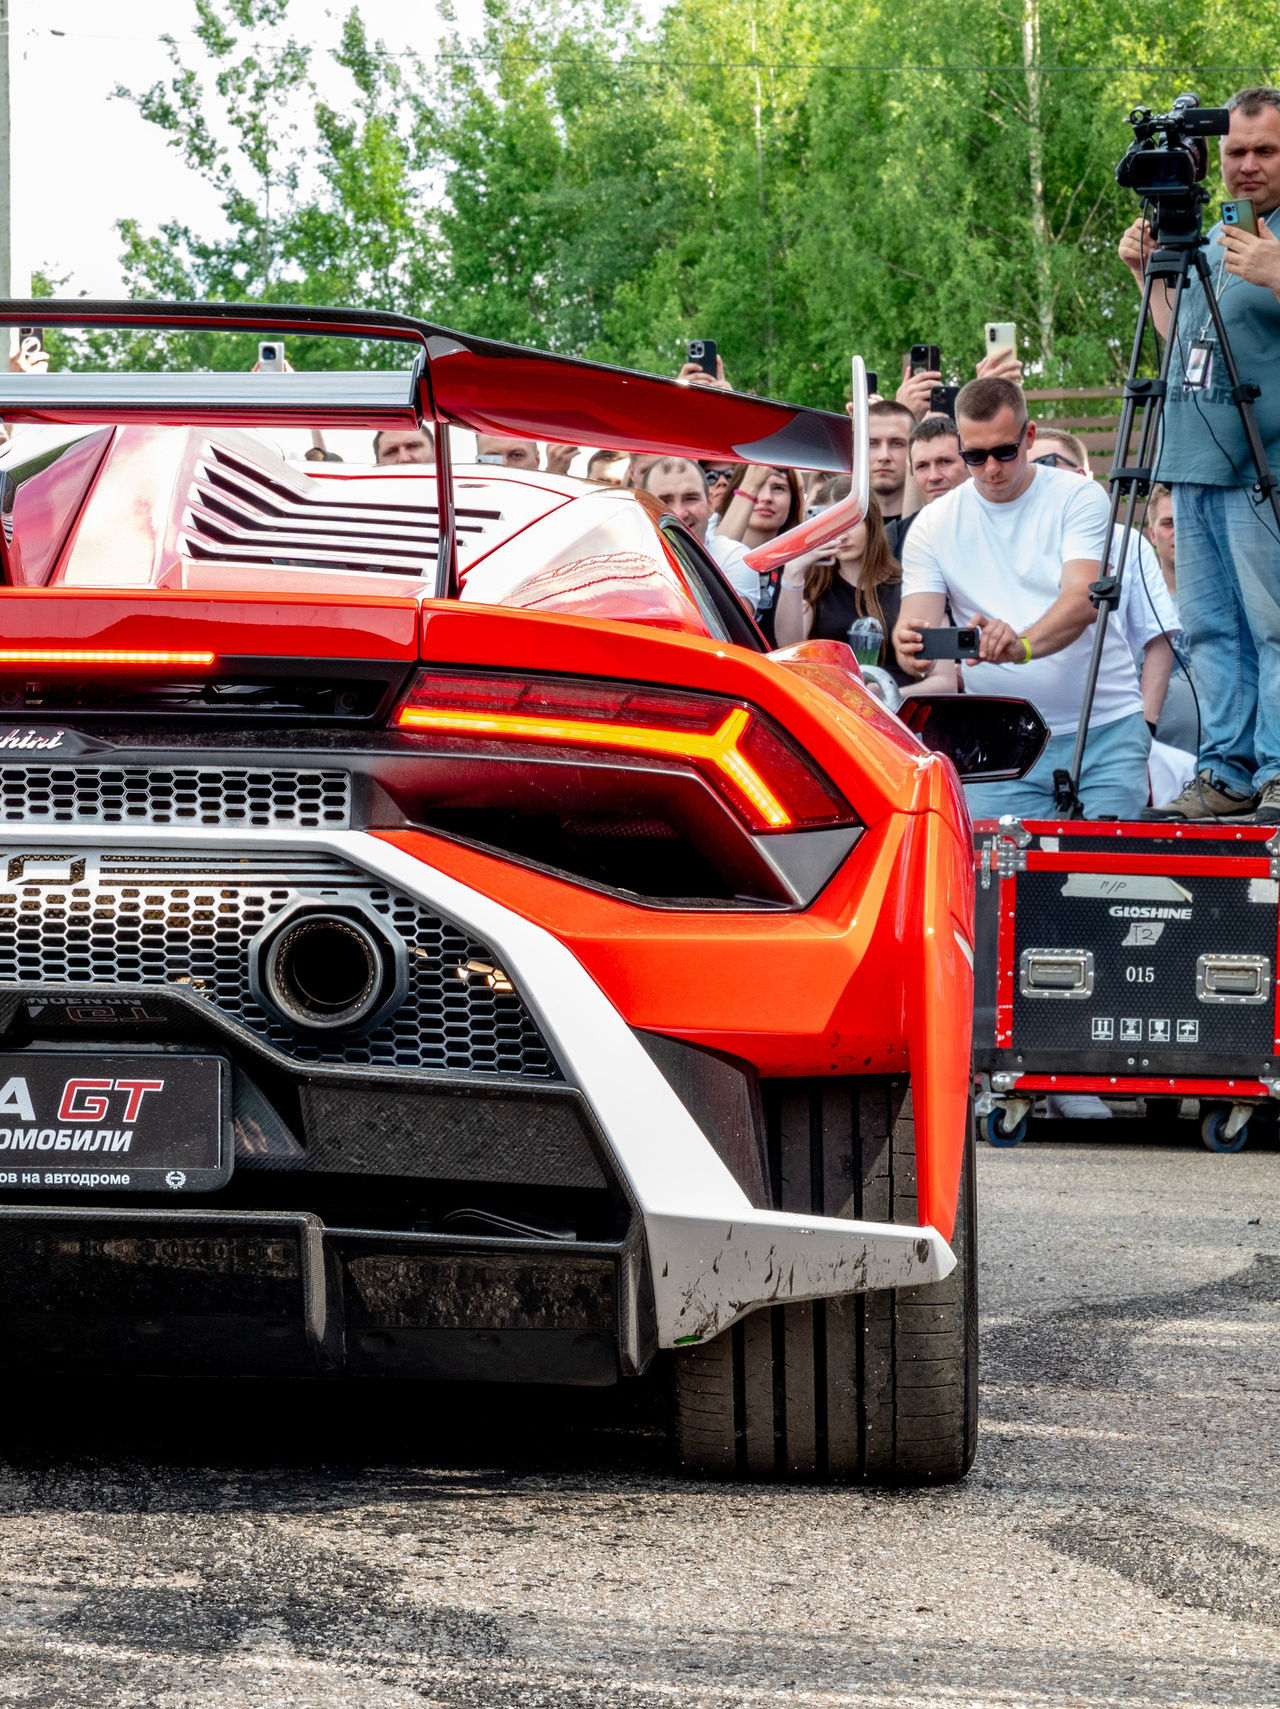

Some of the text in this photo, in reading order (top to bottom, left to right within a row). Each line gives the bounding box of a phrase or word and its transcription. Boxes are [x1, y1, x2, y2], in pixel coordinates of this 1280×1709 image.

[1109, 905, 1193, 919] GLOSHINE
[1133, 925, 1156, 943] T2
[1126, 966, 1155, 982] 015
[57, 1078, 165, 1123] GT
[21, 1172, 41, 1184] на
[44, 1173, 130, 1188] автодроме
